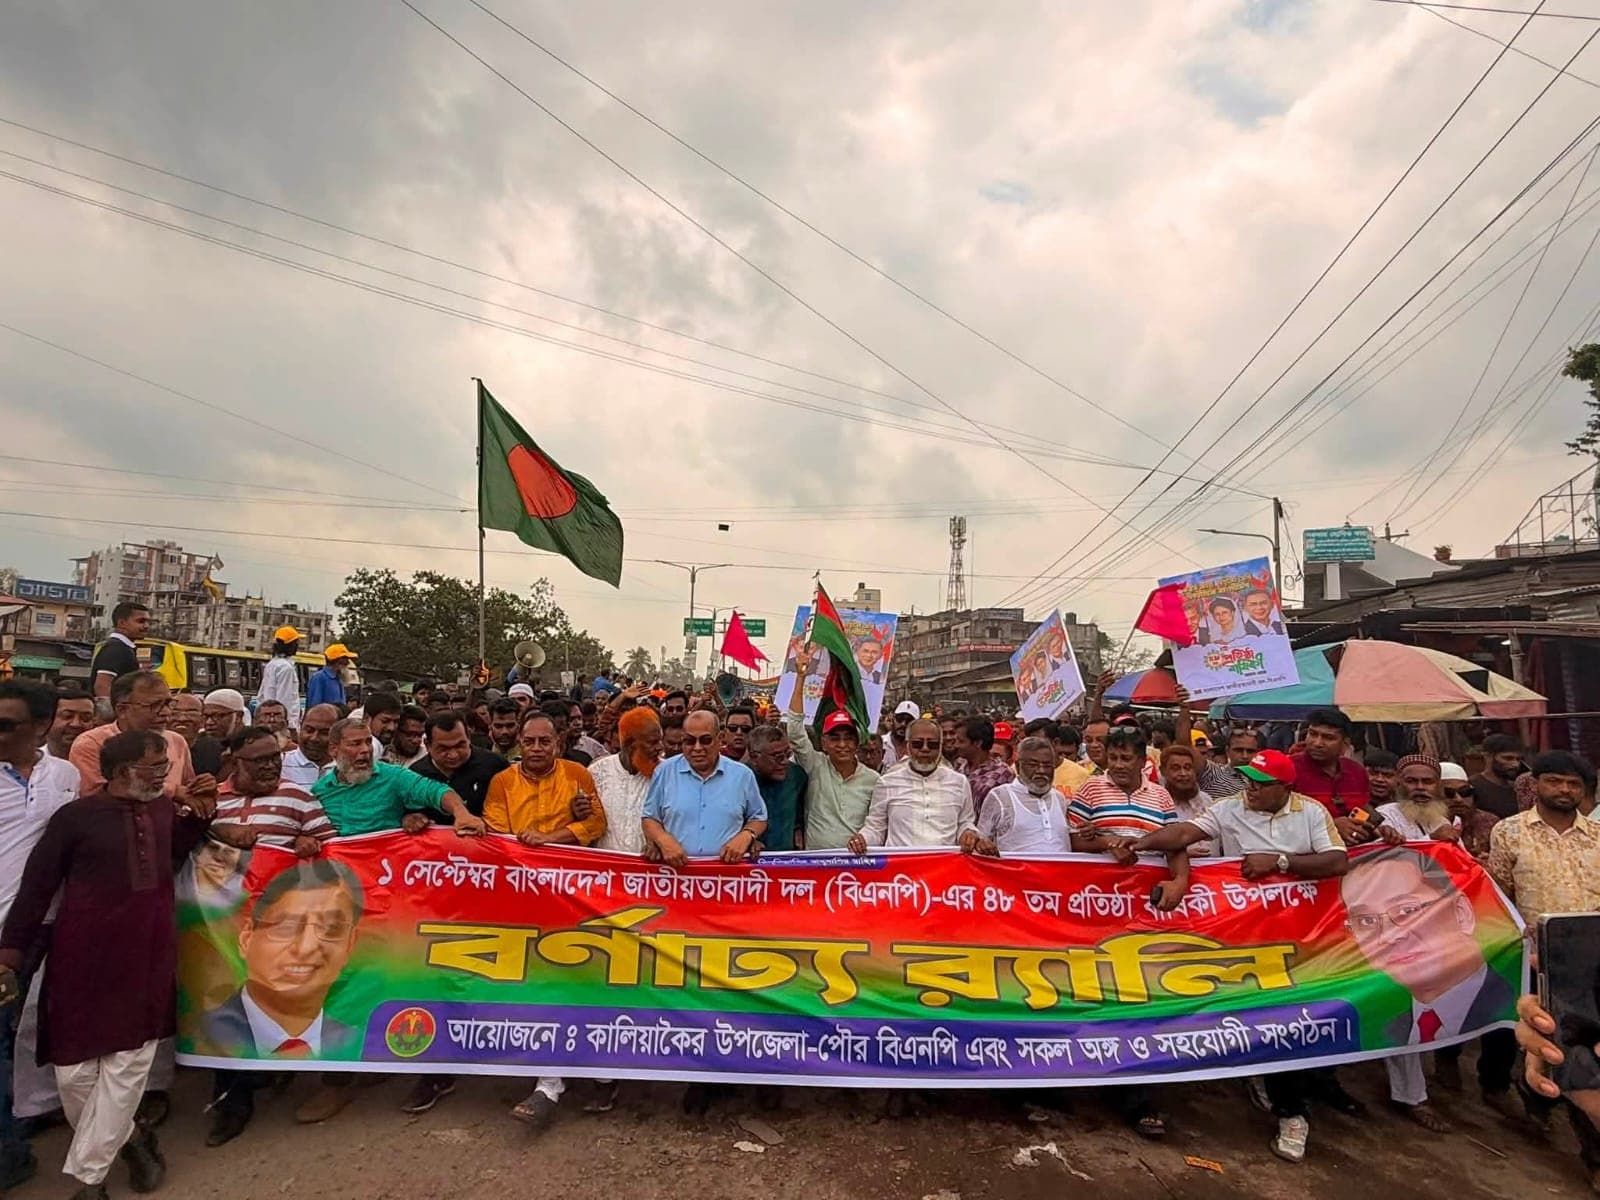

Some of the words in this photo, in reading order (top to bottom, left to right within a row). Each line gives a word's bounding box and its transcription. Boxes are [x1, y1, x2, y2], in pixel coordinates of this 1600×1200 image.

[377, 857, 393, 887] ১
[403, 852, 499, 891] সেপ্টেম্বর
[504, 864, 616, 898] বাংলাদেশ
[621, 866, 772, 904] জাতীয়তাবাদী
[779, 878, 817, 907] দল
[983, 886, 1015, 913] ৪৮
[1022, 889, 1063, 917] তম
[1067, 883, 1136, 919] প্রতিষ্ঠা
[1222, 879, 1319, 911] উপলক্ষে
[417, 906, 869, 1007] বর্ণাঢ্য
[446, 1018, 561, 1053] আয়োজনে
[585, 1014, 708, 1057] কালিয়াকৈর
[875, 1025, 960, 1067] বিএনপি
[965, 1035, 1013, 1069] এবং
[1015, 1038, 1072, 1067] সকল
[1077, 1037, 1121, 1066] অঙ্গ
[1127, 1039, 1150, 1060] ও
[1152, 1016, 1251, 1060] সহযোগী
[1254, 1008, 1338, 1052] সংগঠন
